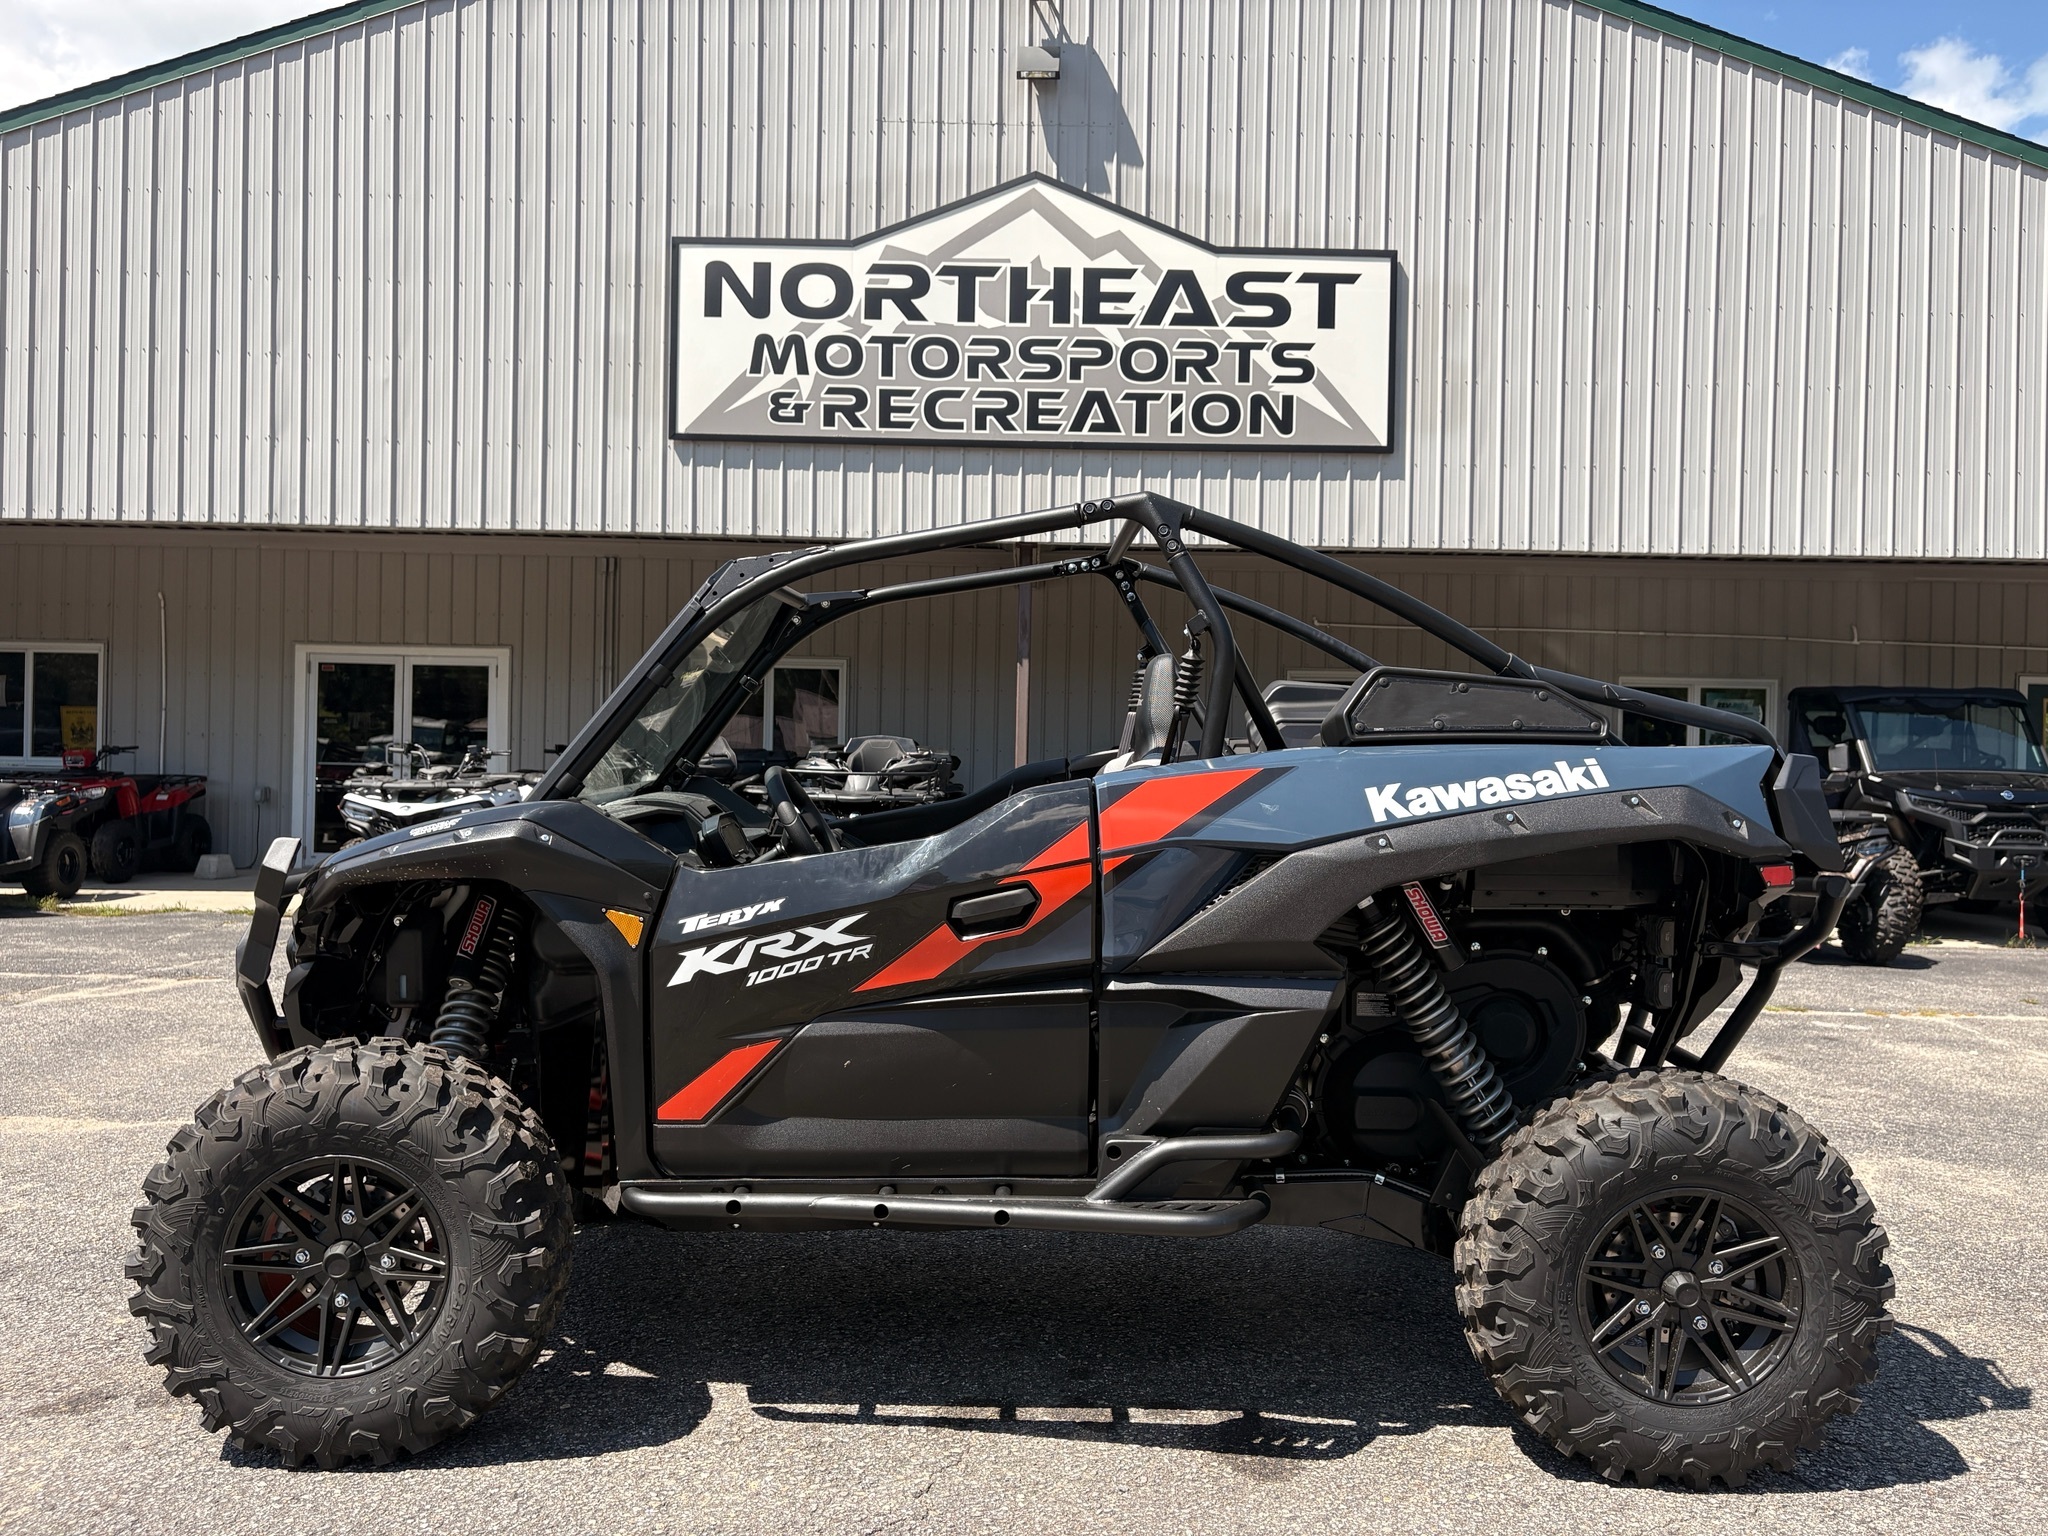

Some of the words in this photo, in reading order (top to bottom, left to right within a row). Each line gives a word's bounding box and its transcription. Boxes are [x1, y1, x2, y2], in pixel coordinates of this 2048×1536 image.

[703, 260, 1364, 330] NORTHEAST
[747, 332, 1317, 384] MOTORSPORTS
[1364, 757, 1611, 823] Kawasaki
[461, 899, 492, 955] SHOWA
[1403, 887, 1449, 943] SHOWA
[666, 912, 871, 988] KRX
[745, 954, 826, 988] 1000
[827, 943, 874, 966] TR
